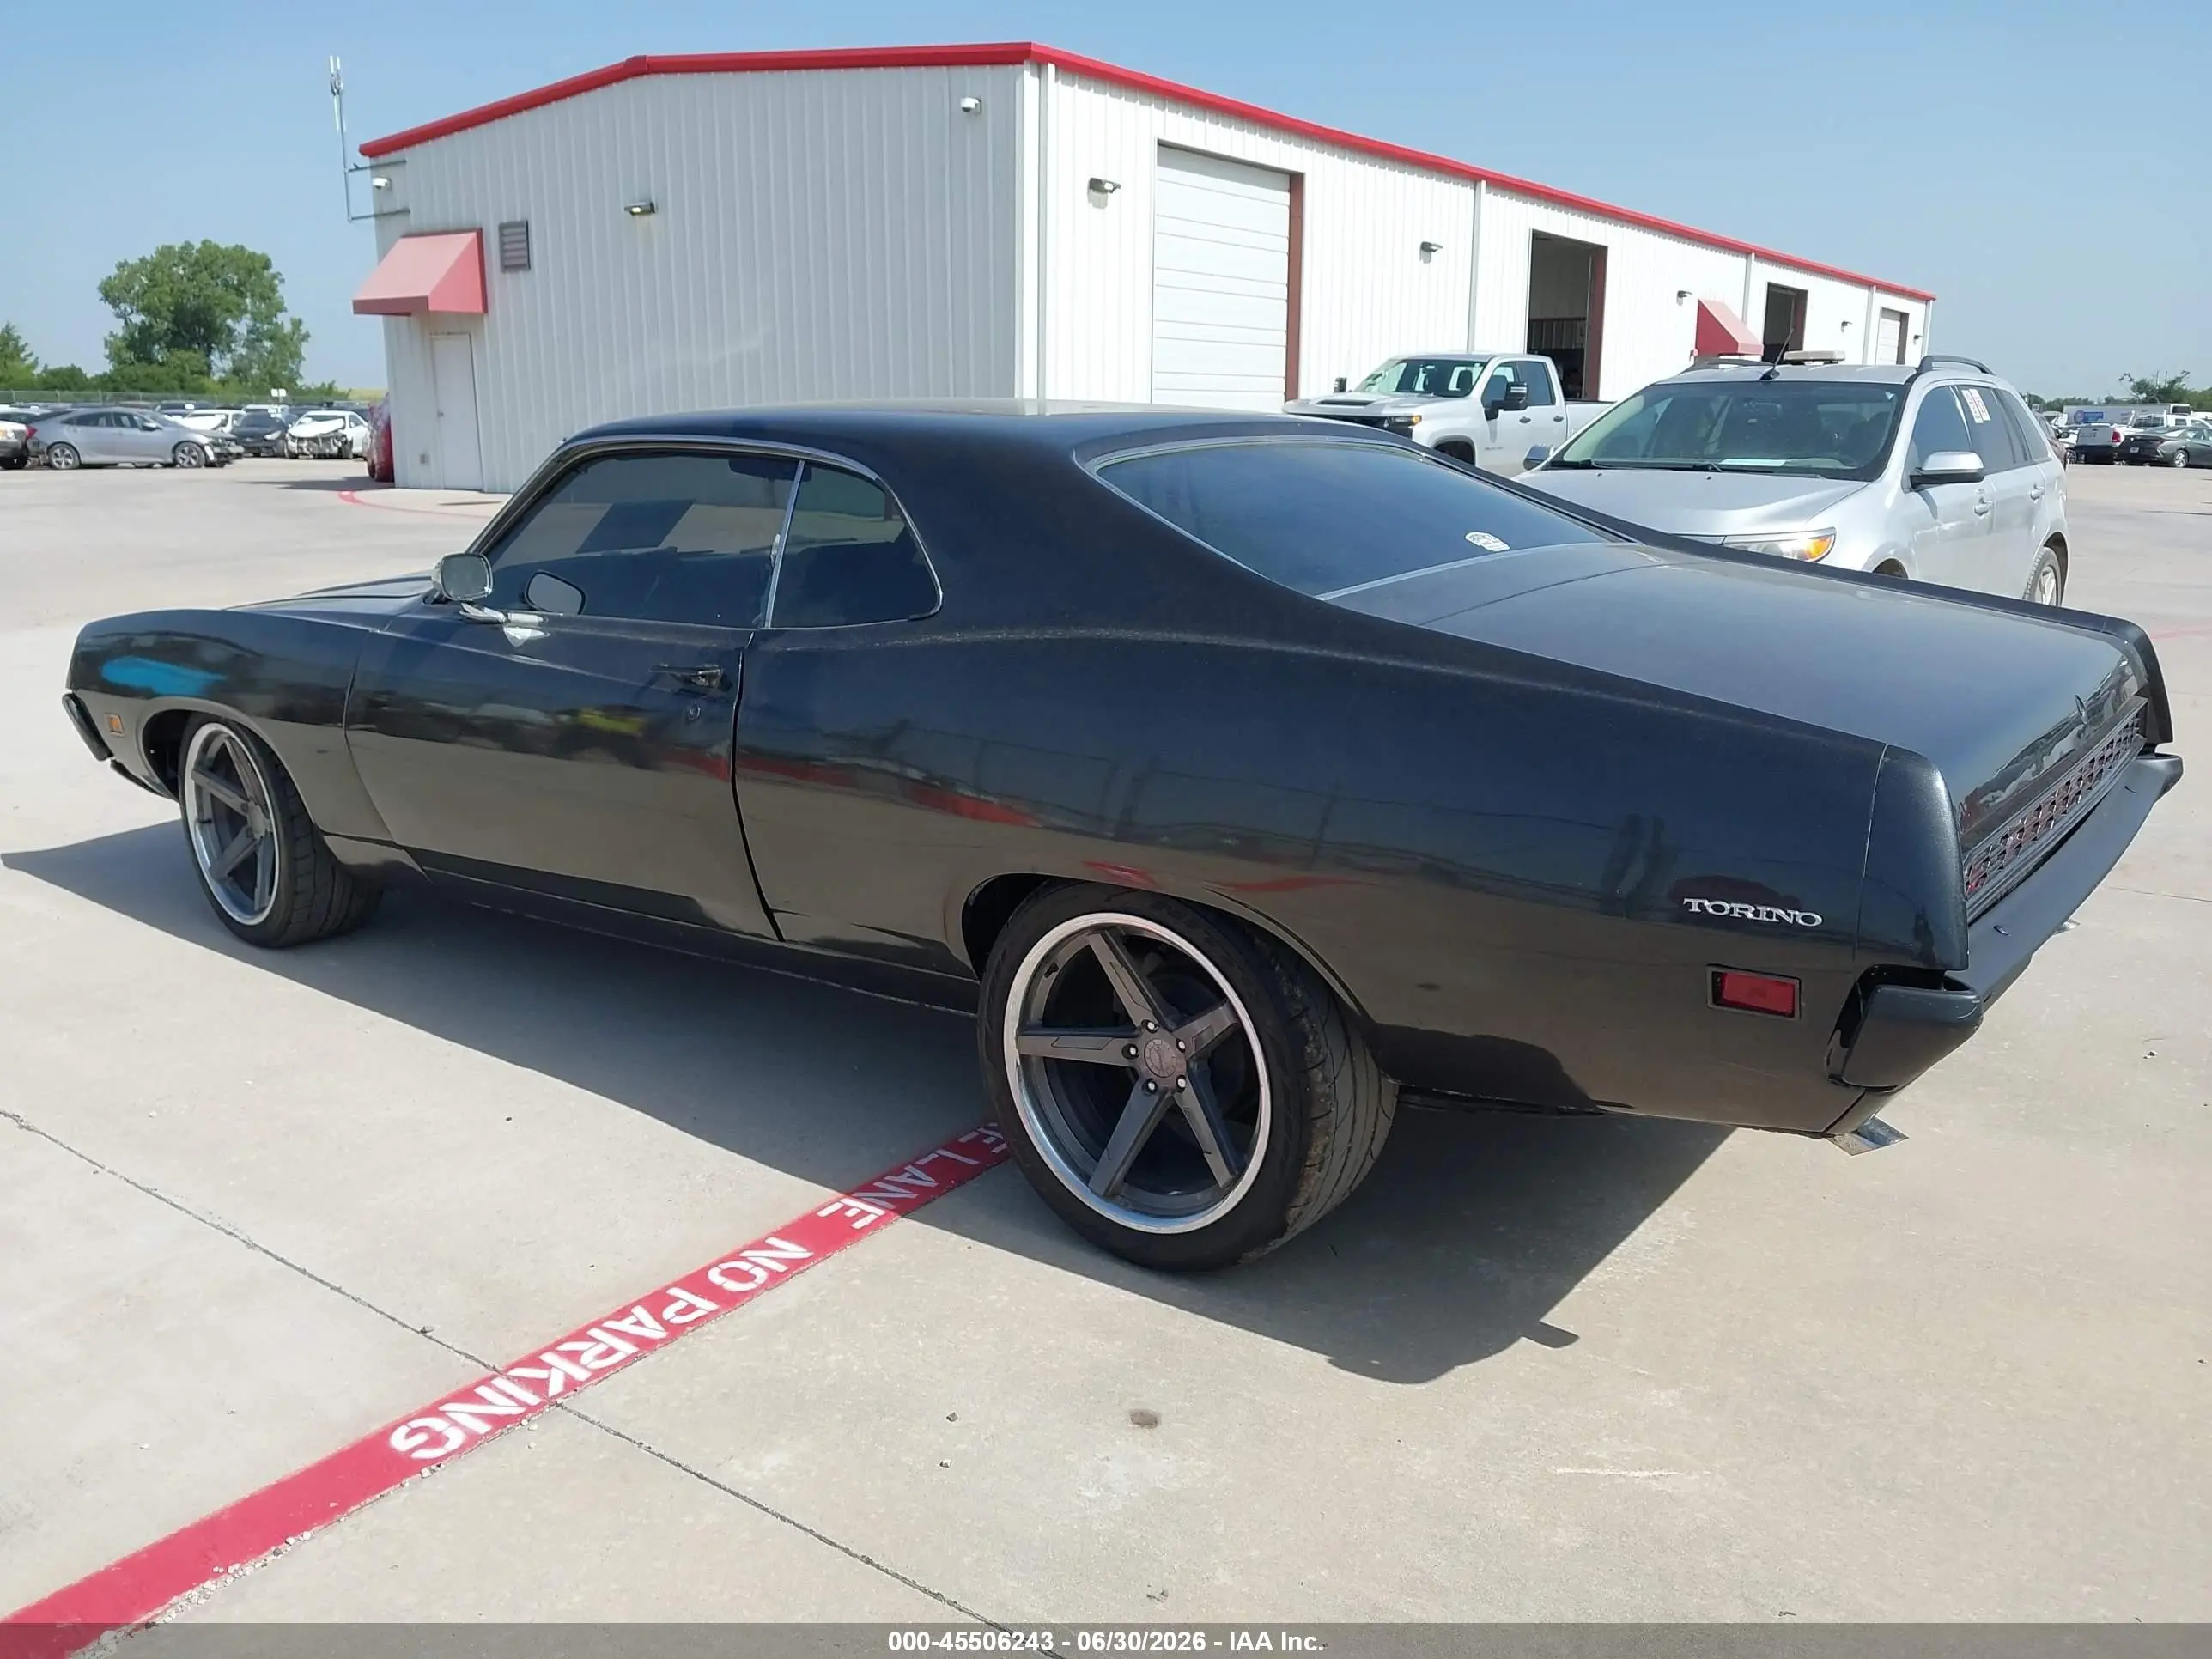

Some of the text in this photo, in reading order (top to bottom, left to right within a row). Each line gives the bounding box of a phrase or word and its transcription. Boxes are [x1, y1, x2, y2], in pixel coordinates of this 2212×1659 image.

[1683, 897, 1823, 927] TORINO
[389, 1149, 980, 1459] LANE NO PARKING
